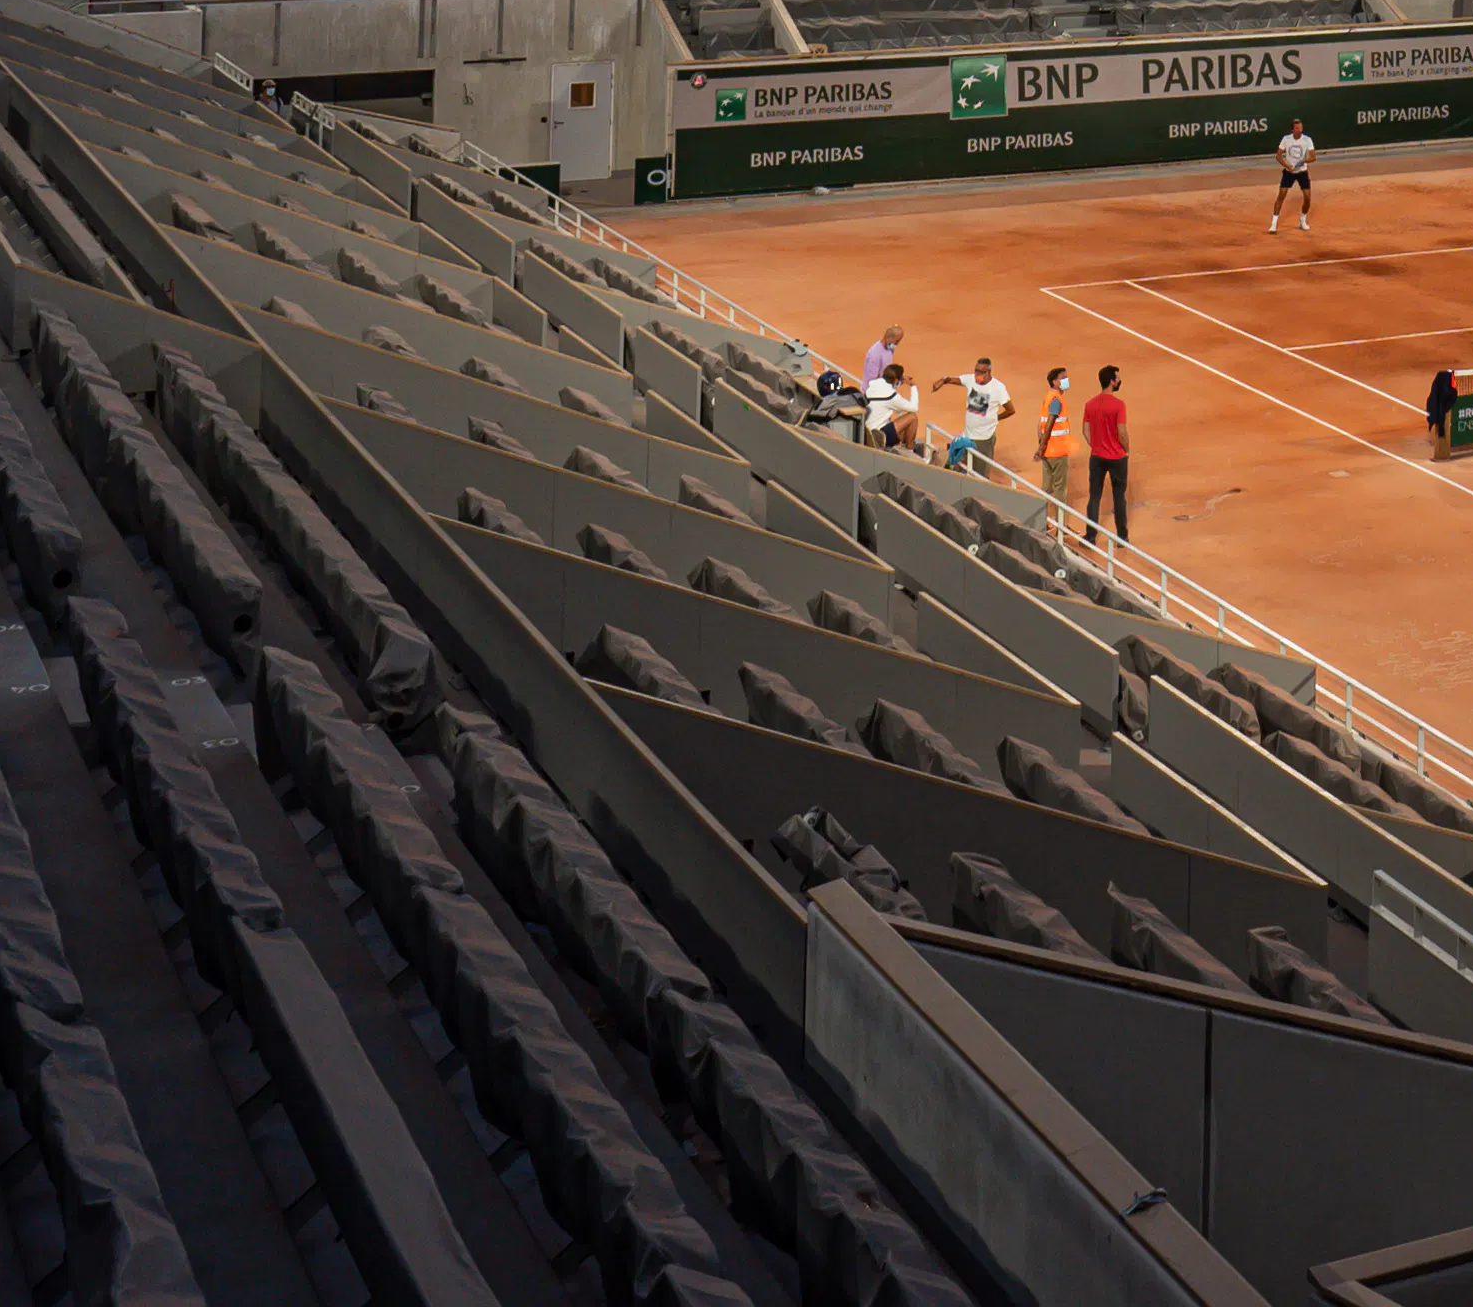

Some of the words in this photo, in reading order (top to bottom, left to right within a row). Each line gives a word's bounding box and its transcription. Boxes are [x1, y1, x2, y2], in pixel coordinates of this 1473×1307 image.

[1371, 50, 1406, 69] BNP
[1016, 62, 1099, 102] BNP
[1142, 49, 1303, 94] PARIBAS
[1371, 69, 1384, 78] The
[1387, 68, 1404, 78] bank
[1406, 67, 1418, 78] for
[1426, 65, 1460, 77] changing
[754, 87, 798, 107] BNP
[804, 81, 893, 104] PARIBAS
[754, 109, 764, 118] La
[766, 107, 795, 118] banque
[819, 104, 847, 114] monde
[849, 102, 862, 114] qui
[864, 101, 894, 113] change
[1357, 109, 1387, 125] BNP
[1390, 104, 1450, 123] PARIBAS
[1169, 122, 1201, 139] BNP
[1204, 117, 1269, 137] PARIBAS
[967, 137, 1002, 154] BNP
[1004, 131, 1075, 151] PARIBAS
[750, 151, 787, 168] BNP
[791, 145, 865, 165] PARIBAS
